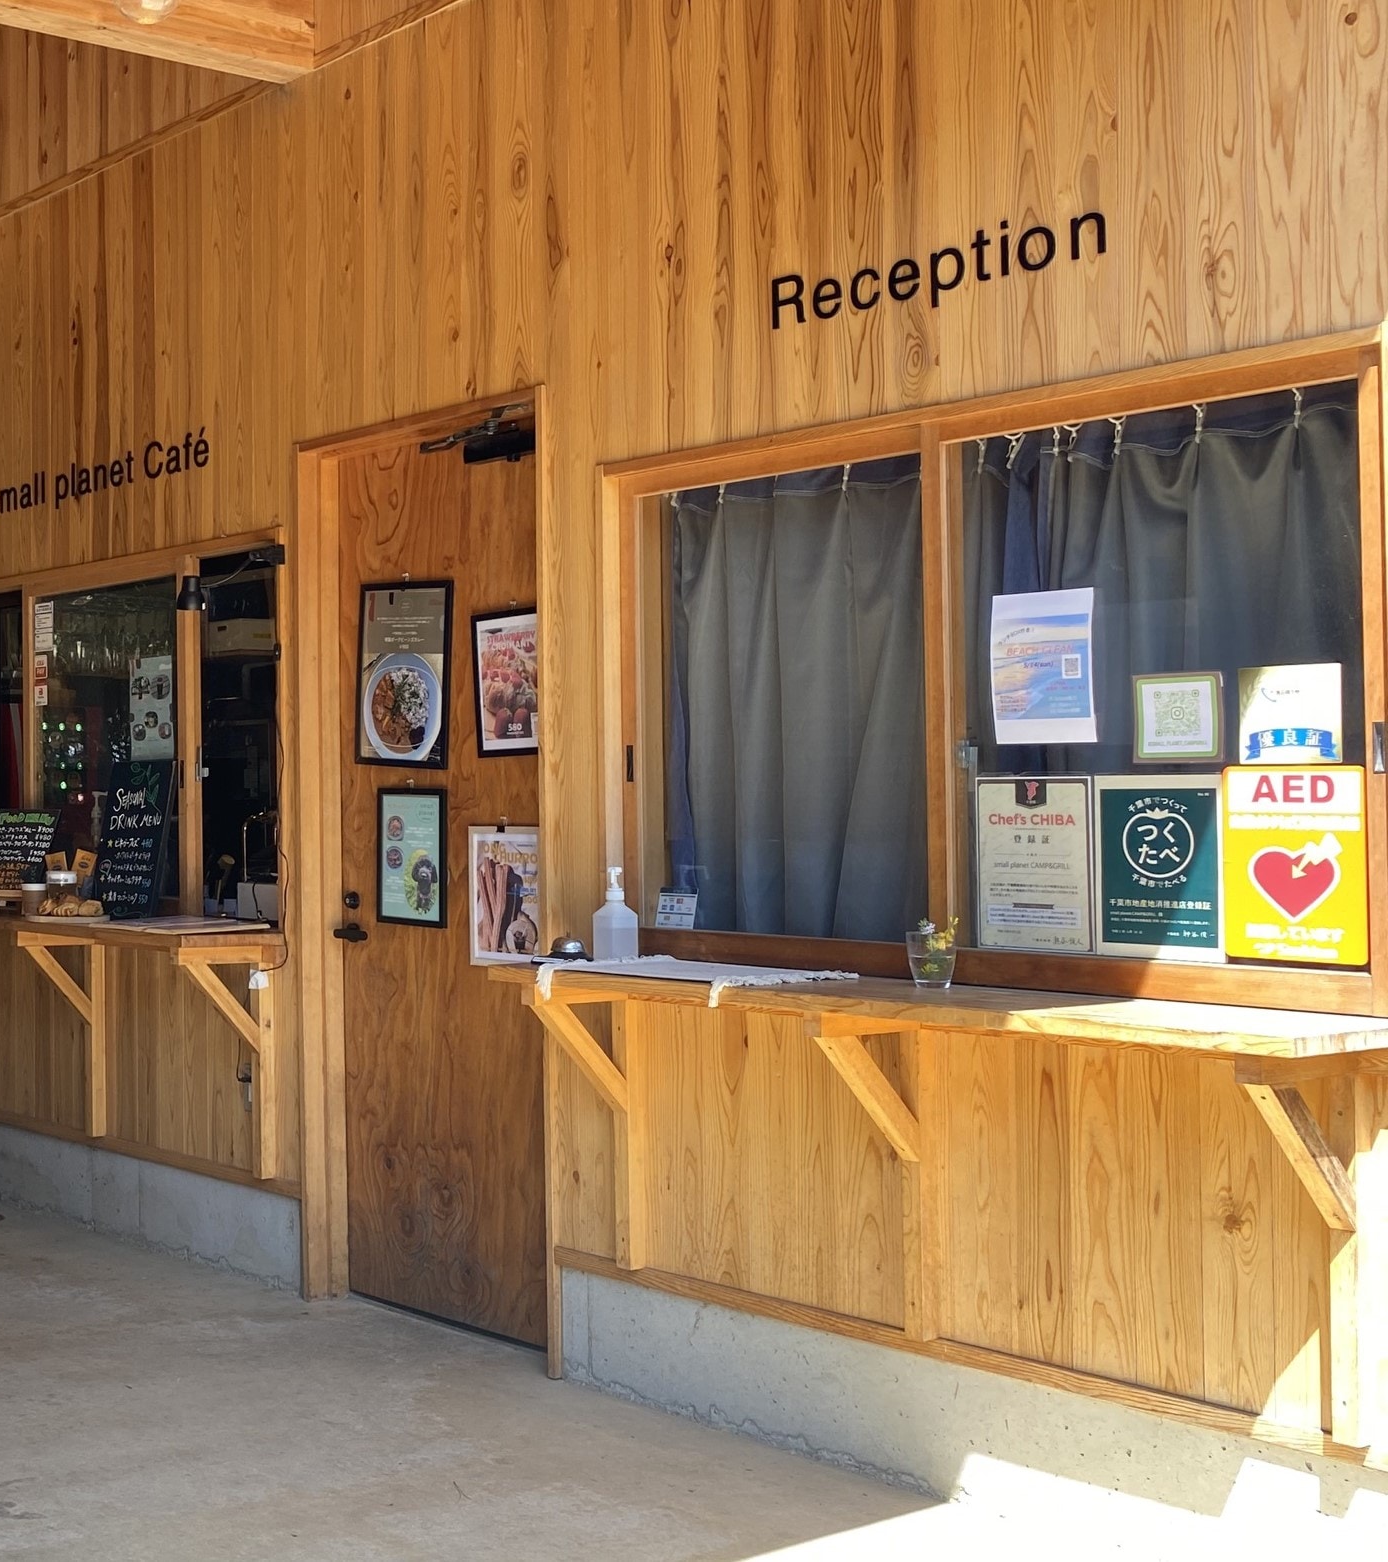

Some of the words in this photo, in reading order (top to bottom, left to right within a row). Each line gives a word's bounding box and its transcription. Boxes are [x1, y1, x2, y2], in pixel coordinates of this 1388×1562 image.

[772, 212, 1106, 329] Reception
[55, 451, 134, 509] planet
[144, 427, 209, 479] Café
[1006, 646, 1039, 656] BEACH
[1042, 644, 1074, 655] CLEAN
[1259, 730, 1323, 747] 優良証
[1252, 775, 1335, 803] AED
[1128, 797, 1188, 814] 千葉市でつくって
[109, 814, 139, 830] DRINK
[140, 812, 162, 827] MENU
[988, 813, 1027, 826] Chef's
[1030, 814, 1076, 826] CHIBA
[1014, 835, 1050, 844] 登録証
[1137, 821, 1175, 843] つく
[1138, 844, 1180, 865] たべ
[1010, 861, 1030, 870] planet
[1030, 861, 1071, 870] CAMP&GRILL
[1132, 873, 1187, 889] 千葉市でたべる
